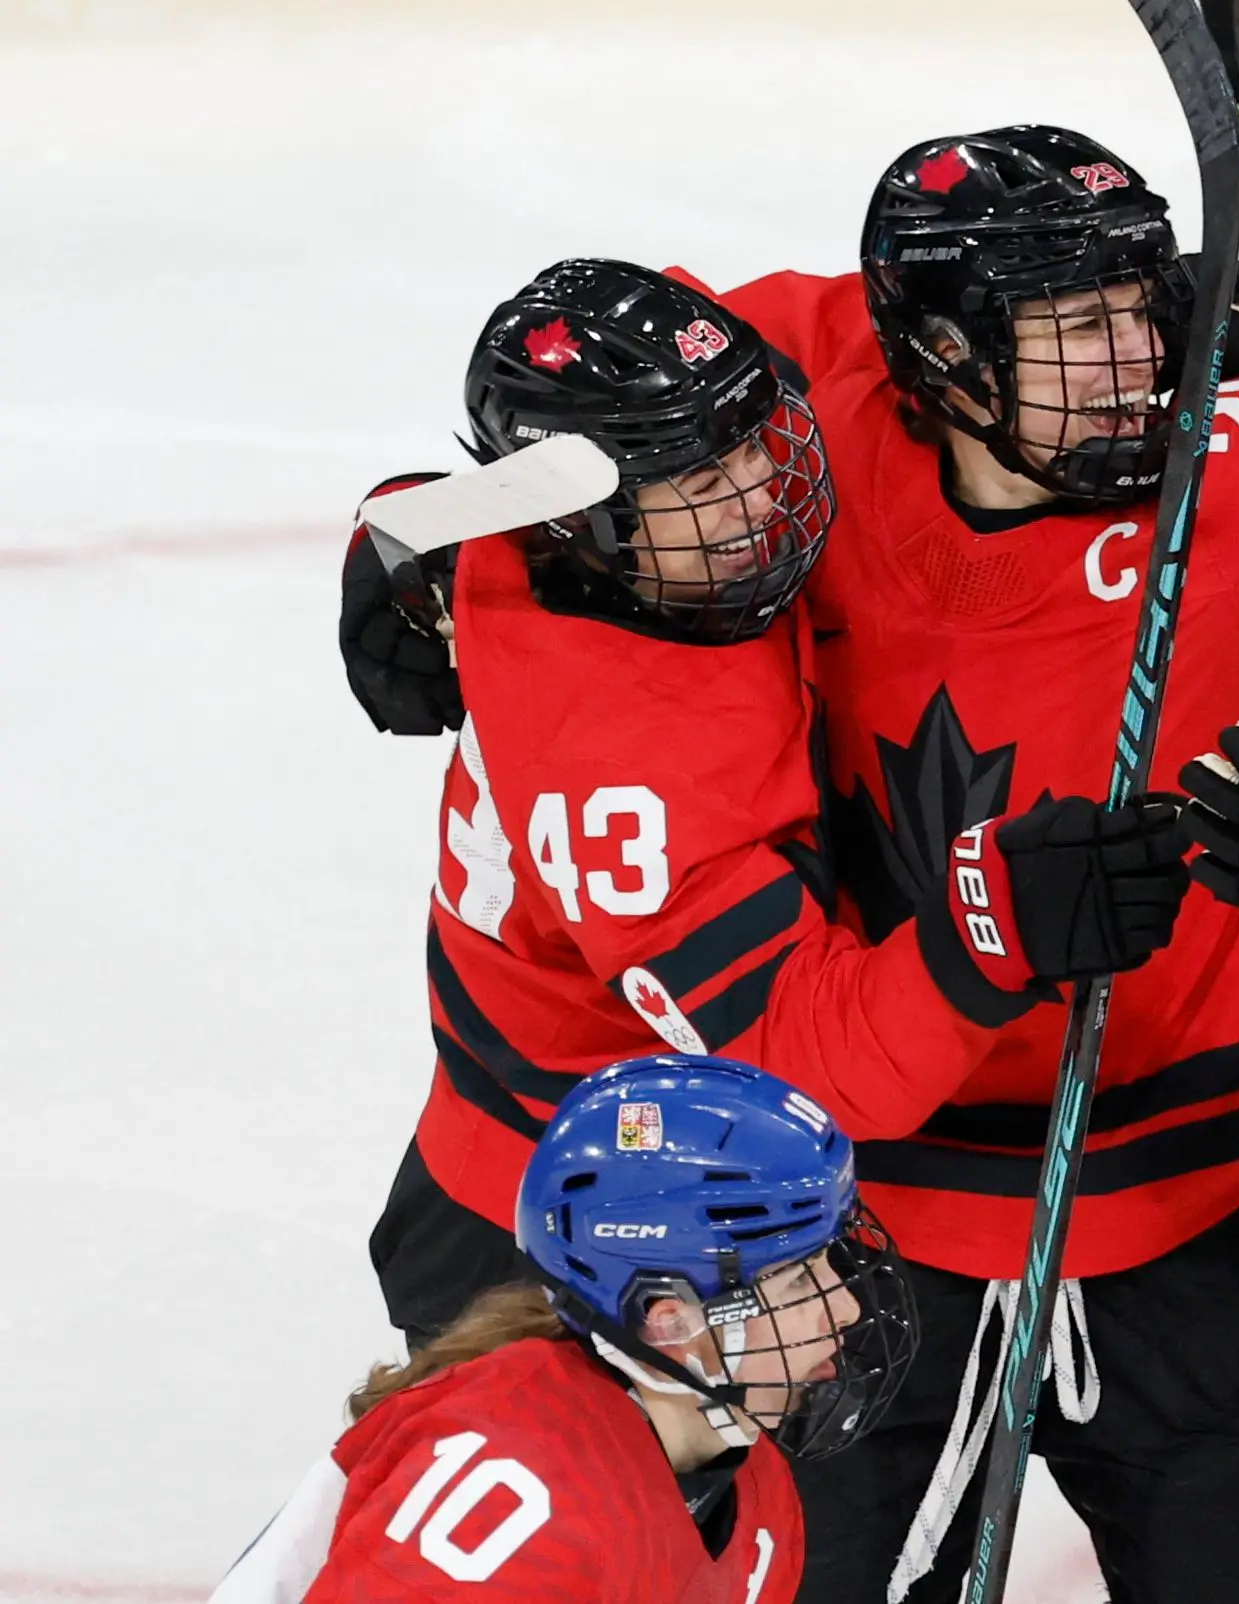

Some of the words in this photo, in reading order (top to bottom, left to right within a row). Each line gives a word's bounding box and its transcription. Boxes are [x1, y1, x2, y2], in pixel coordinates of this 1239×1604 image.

[1071, 163, 1130, 193] 29
[675, 319, 729, 364] 43
[909, 334, 949, 373] AUER
[516, 425, 585, 441] BAU
[1084, 521, 1138, 602] C
[527, 784, 671, 923] 43
[954, 818, 1006, 957] BAU
[593, 1223, 668, 1239] CCM
[708, 1305, 760, 1326] CCM
[384, 1430, 552, 1583] 10
[971, 1516, 995, 1604] AUER
